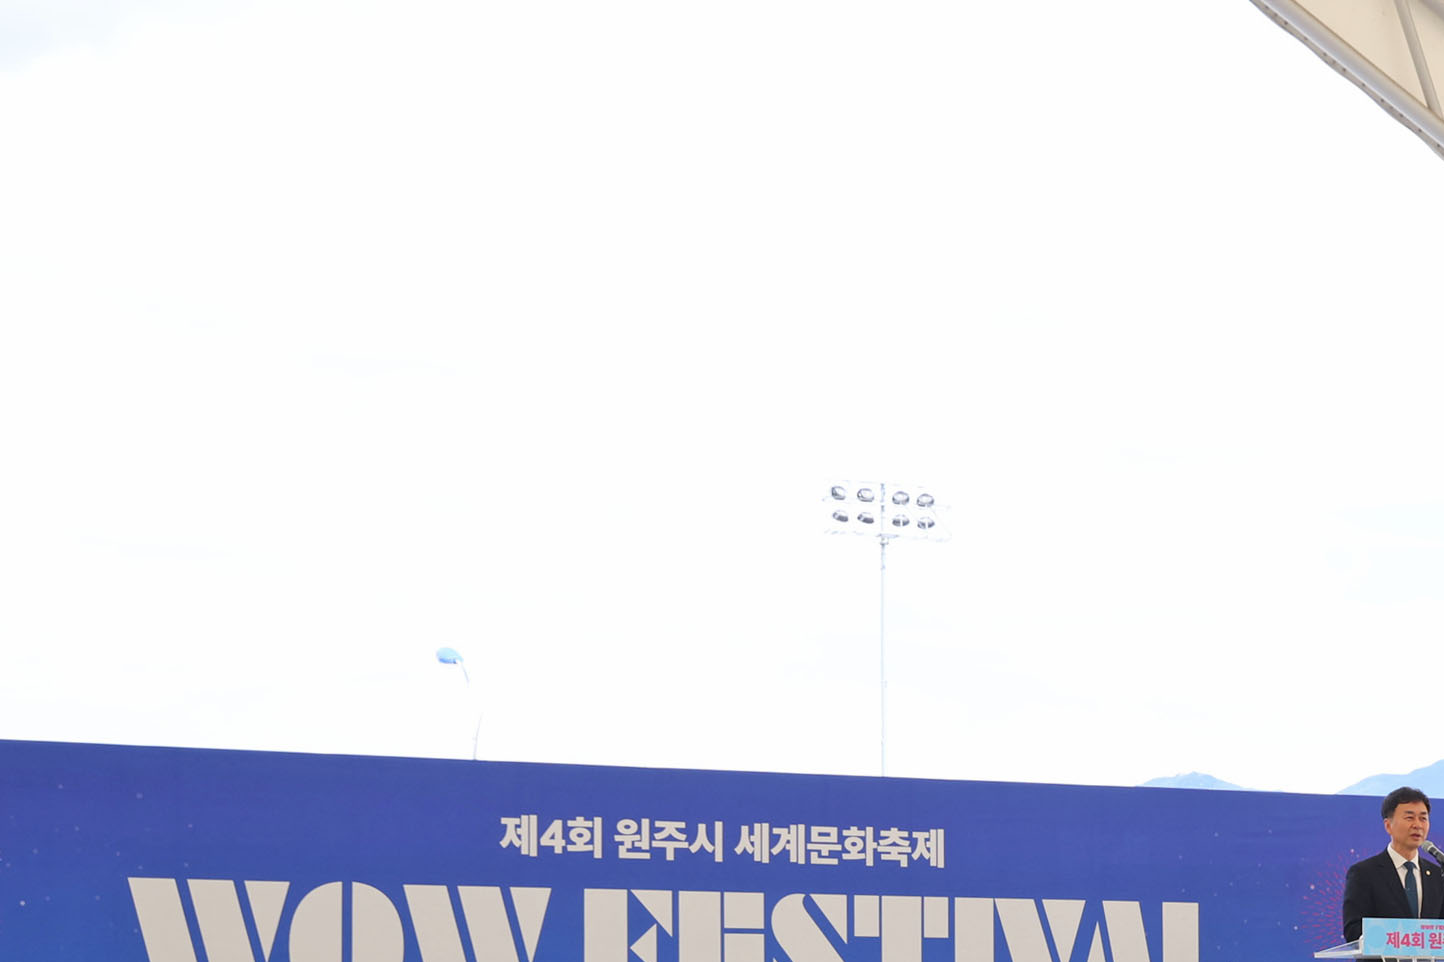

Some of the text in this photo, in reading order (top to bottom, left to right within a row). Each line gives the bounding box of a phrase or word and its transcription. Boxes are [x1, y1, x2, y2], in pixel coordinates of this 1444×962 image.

[499, 815, 945, 869] 제4회 원주시 세계문화축제
[1386, 931, 1425, 949] 제4회
